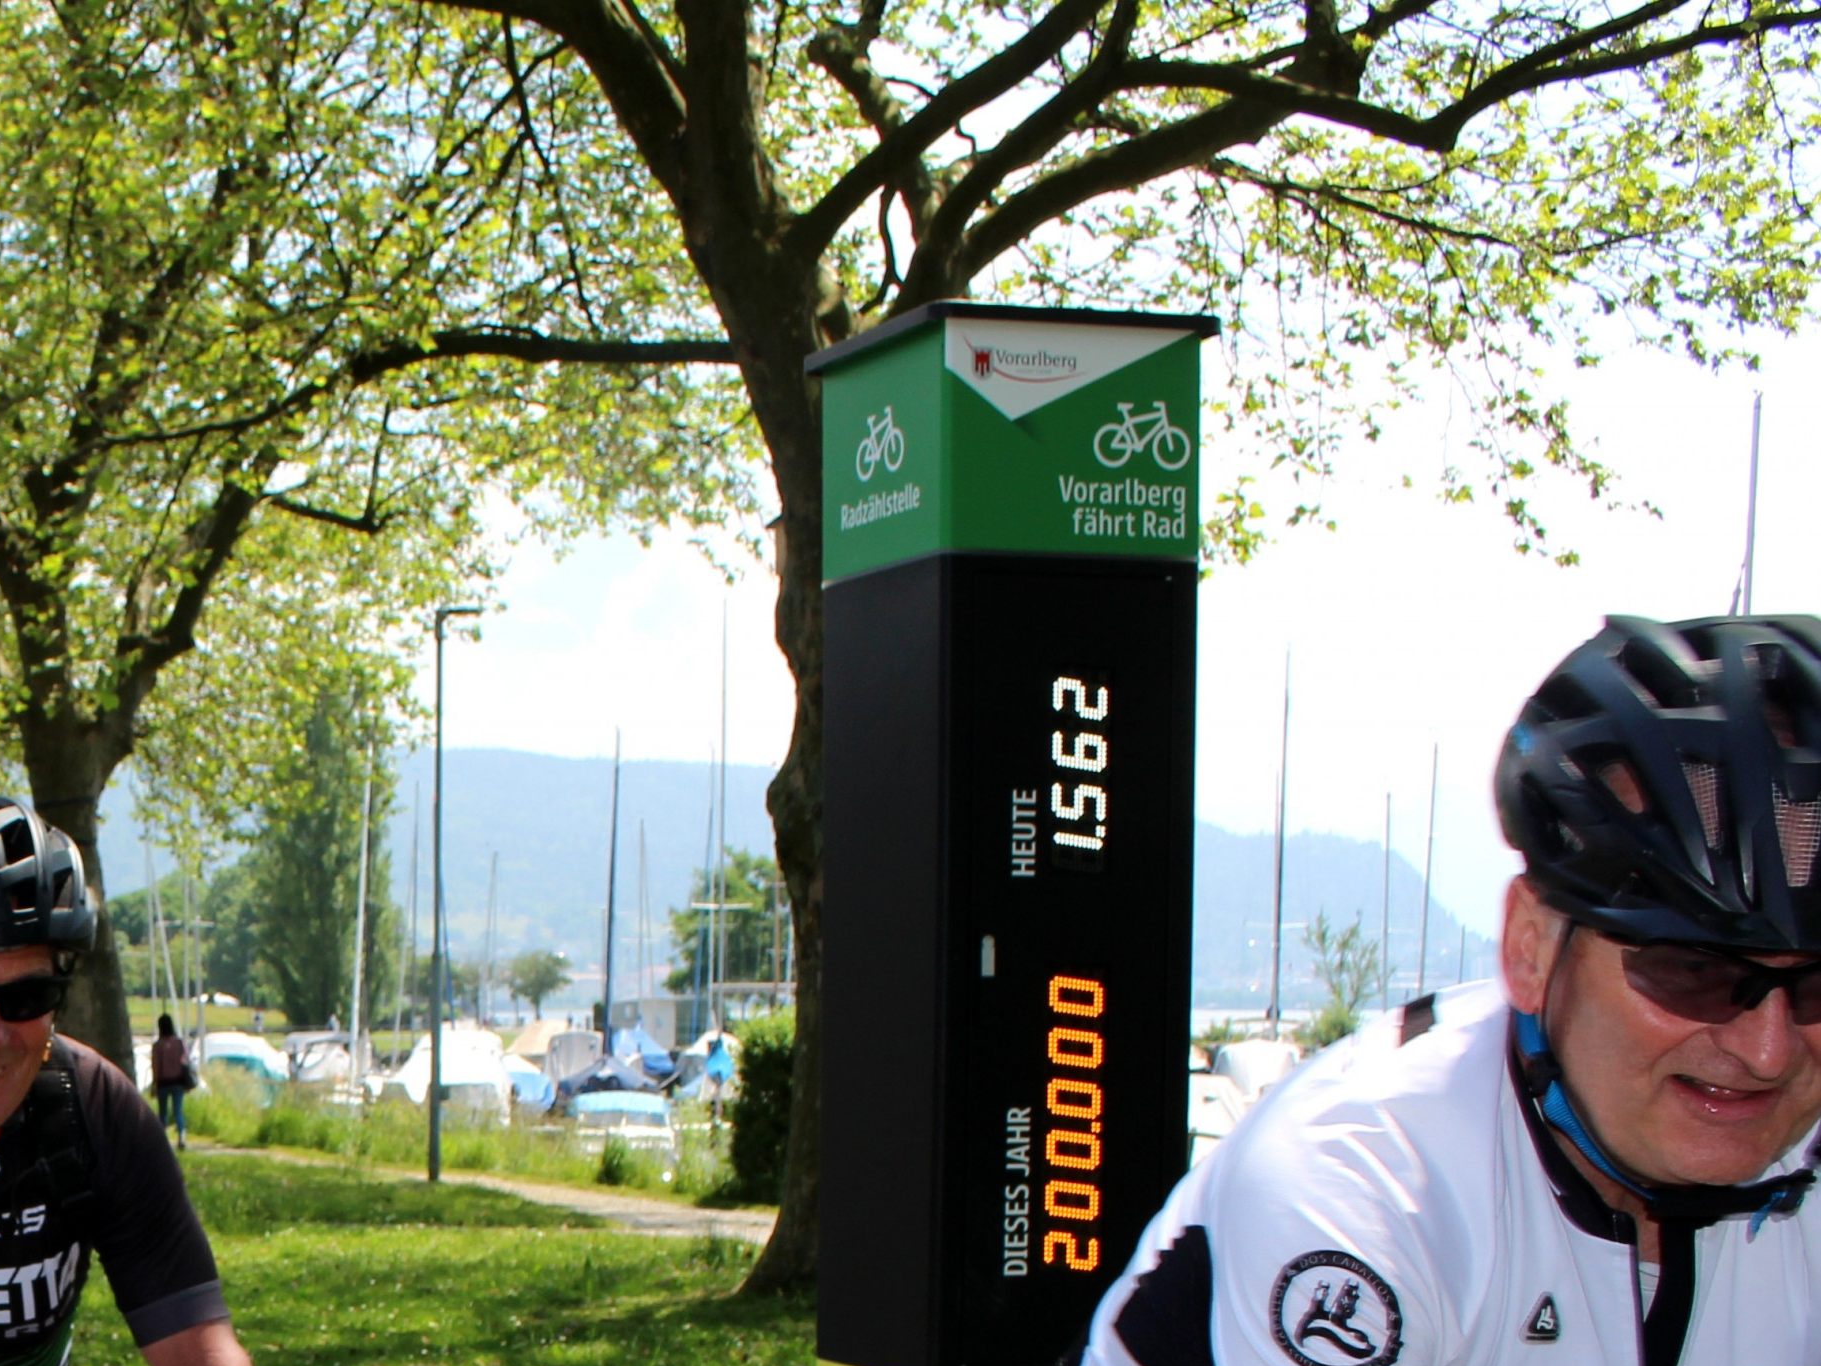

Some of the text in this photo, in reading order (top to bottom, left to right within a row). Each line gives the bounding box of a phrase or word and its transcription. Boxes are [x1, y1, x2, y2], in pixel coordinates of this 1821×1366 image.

[996, 349, 1077, 373] Vorarlberg
[840, 485, 920, 532] Radzählstelle
[1059, 475, 1186, 513] Vorarlberg
[1072, 507, 1186, 539] fährt Rad
[1011, 788, 1037, 877] HEUTE
[1043, 975, 1106, 1272] 200.000
[1003, 1106, 1032, 1277] DIESES JAHR
